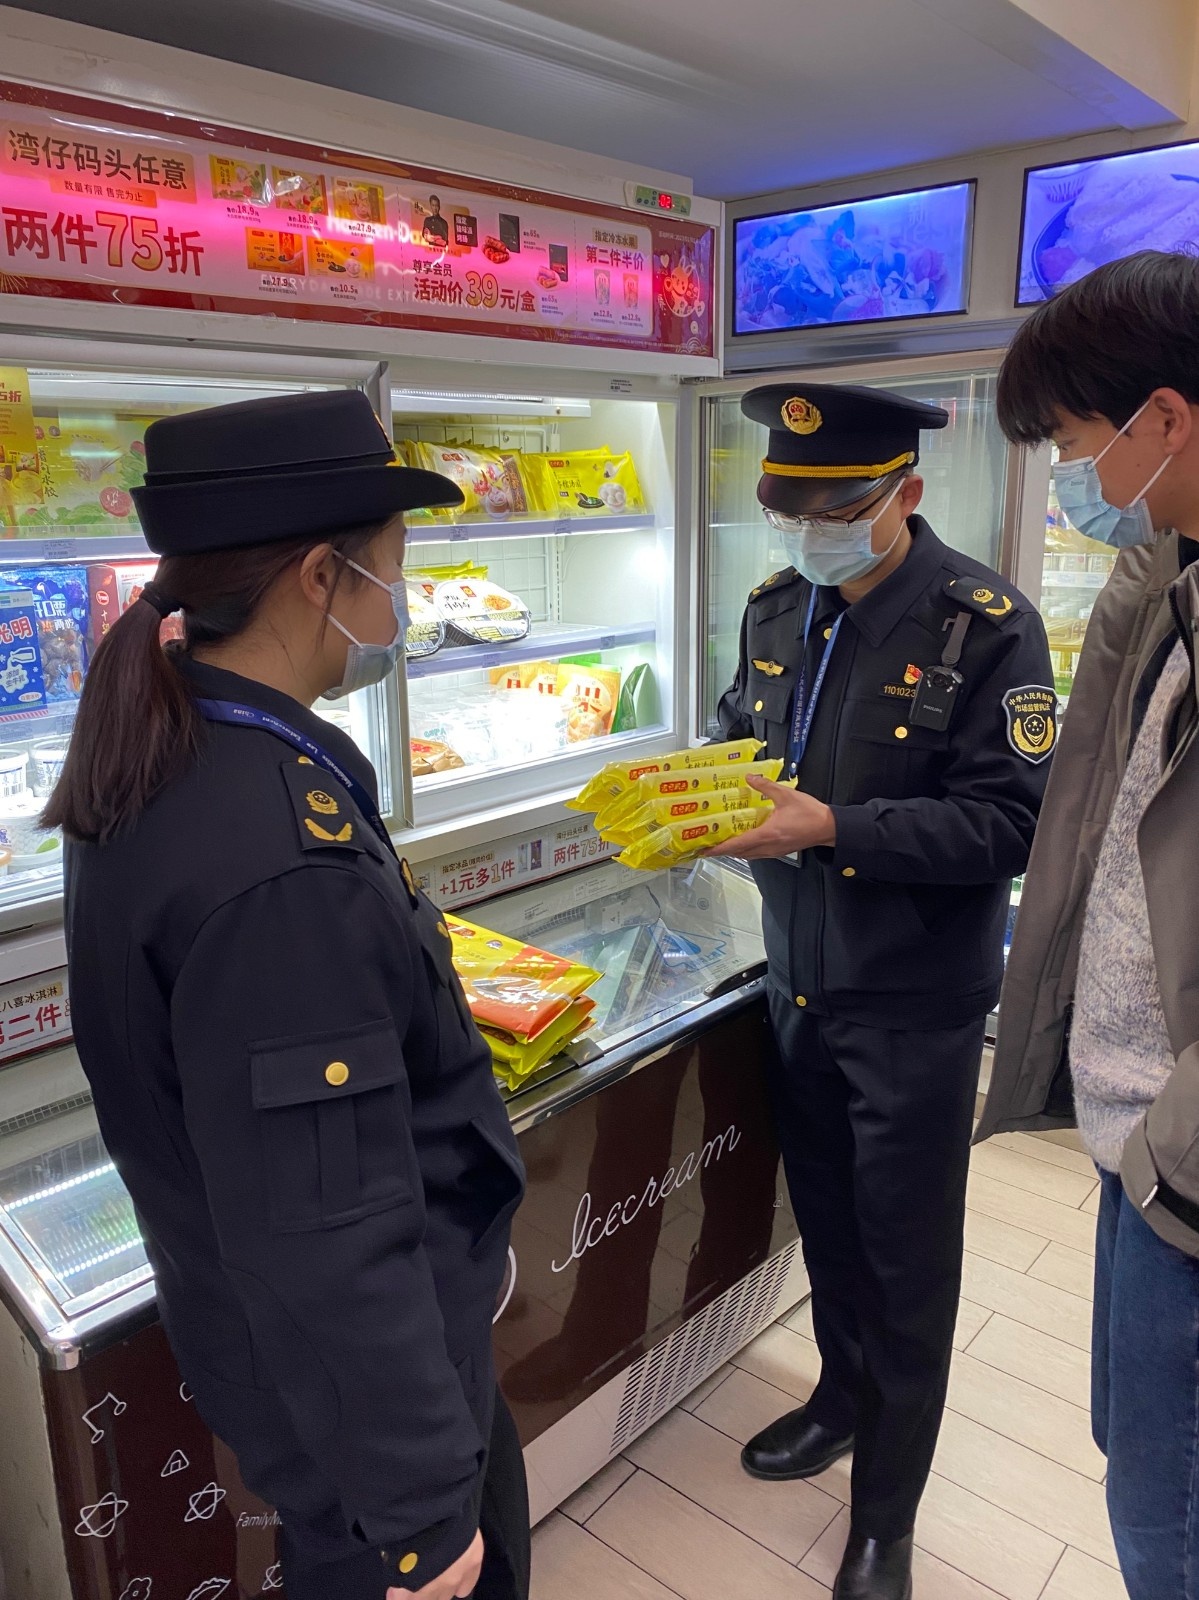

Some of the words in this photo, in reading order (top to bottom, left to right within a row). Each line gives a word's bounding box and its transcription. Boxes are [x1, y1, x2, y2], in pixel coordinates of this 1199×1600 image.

[8, 129, 187, 190] 湾仔码头任意
[64, 180, 103, 196] 数量有限
[106, 187, 143, 202] 售完为止
[2, 207, 204, 276] 两件75折
[586, 245, 644, 271] 第二件半价
[413, 259, 453, 277] 尊享会员
[414, 270, 536, 313] 活动价39元/盒
[1014, 702, 1051, 713] 市场监管执法
[554, 836, 610, 867] 两件75折
[440, 859, 516, 895] +1元多1件
[0, 1003, 61, 1045] 二件
[551, 1124, 741, 1273] Icecream
